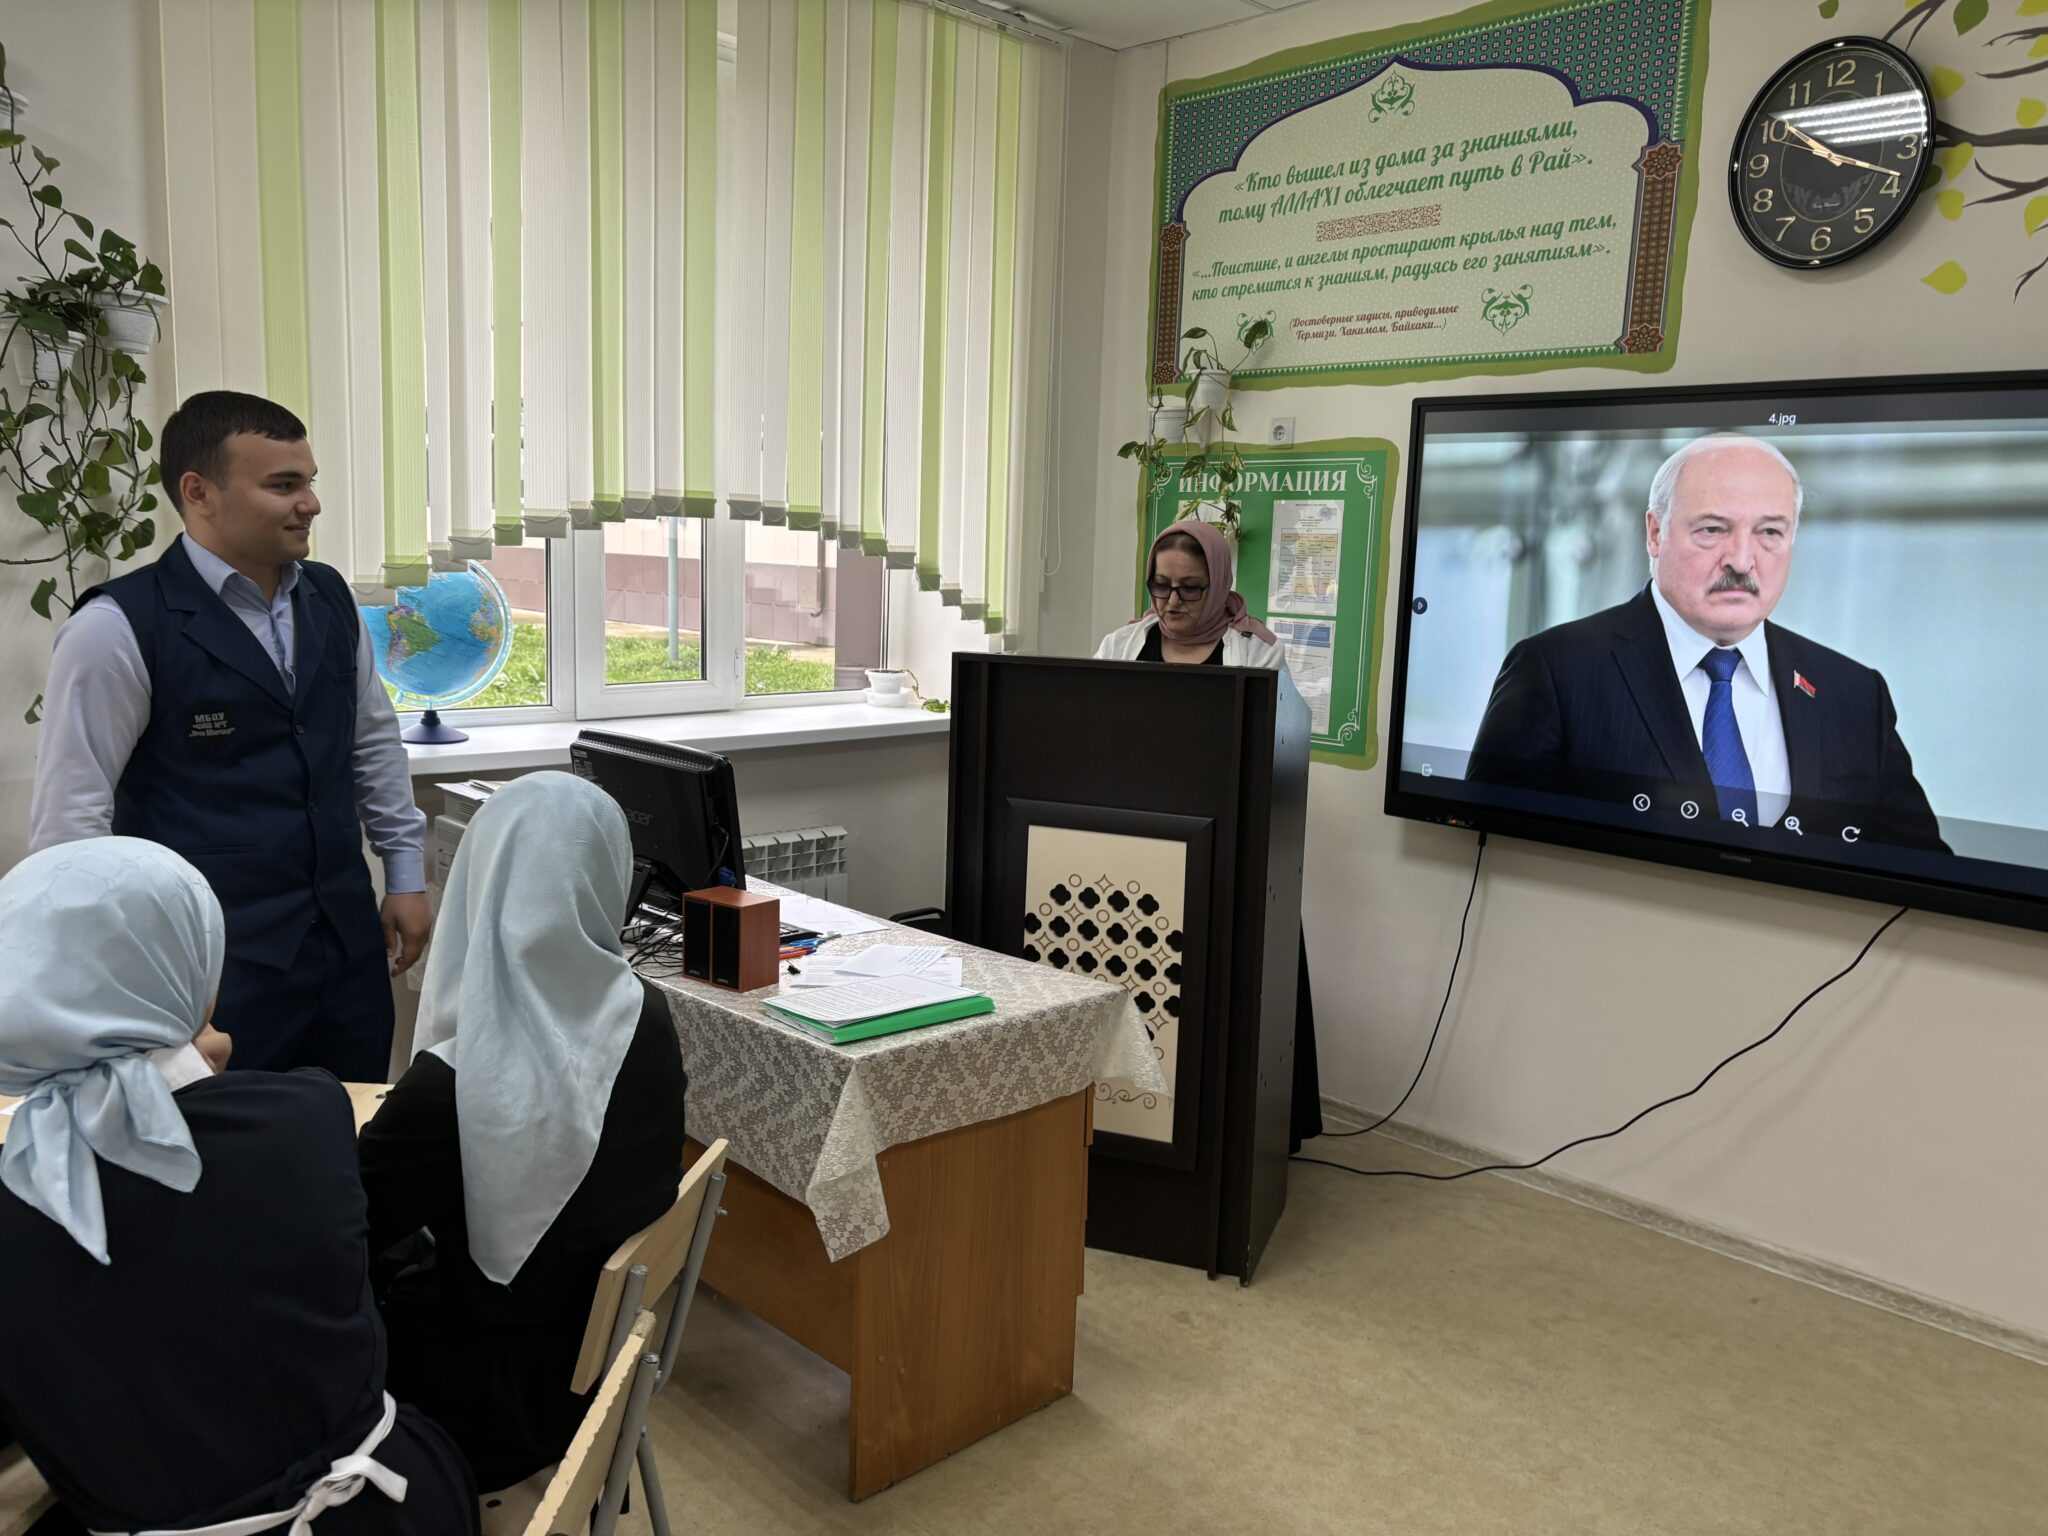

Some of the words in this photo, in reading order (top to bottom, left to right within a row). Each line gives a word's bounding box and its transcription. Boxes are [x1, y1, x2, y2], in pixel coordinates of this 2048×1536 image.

[1826, 59, 1857, 88] 12
[1874, 70, 1884, 97] 1
[1788, 79, 1812, 107] 11
[1760, 118, 1790, 144] 10
[1234, 171, 1281, 192] «Кто
[1286, 164, 1345, 186] вышел
[1349, 157, 1371, 178] из
[1375, 146, 1427, 176] дома
[1430, 142, 1455, 167] за
[1459, 119, 1578, 162] знаниями,
[1896, 133, 1919, 160] 3
[1749, 153, 1770, 178] 9
[1219, 202, 1266, 223] тому
[1345, 174, 1443, 202] облегчает
[1448, 164, 1505, 192] путь
[1510, 154, 1524, 177] в
[1528, 146, 1593, 174] Рай».
[1879, 174, 1901, 199] 4
[1753, 187, 1774, 213] 8
[1775, 215, 1796, 242] 7
[1853, 207, 1875, 234] 5
[1284, 256, 1295, 269] и
[1296, 248, 1349, 267] ангелы
[1351, 235, 1456, 264] простирают
[1459, 227, 1526, 251] крылья
[1529, 219, 1565, 241] над
[1568, 214, 1617, 234] тем,
[1810, 226, 1832, 252] 6
[1192, 287, 1218, 301] кто
[1221, 277, 1301, 300] стремится
[1304, 276, 1314, 289] к
[1317, 267, 1389, 292] знаниям,
[1391, 258, 1458, 283] радуясь
[1462, 255, 1488, 271] его
[1492, 242, 1611, 273] занятиям».
[1289, 315, 1355, 330] (Достоверные
[1356, 310, 1393, 323] хадисы,
[1394, 304, 1460, 321] приводимые
[1340, 325, 1388, 337] Хакимом,
[1391, 318, 1447, 333] Байхаки...)
[1768, 412, 1797, 426] 4.jpg
